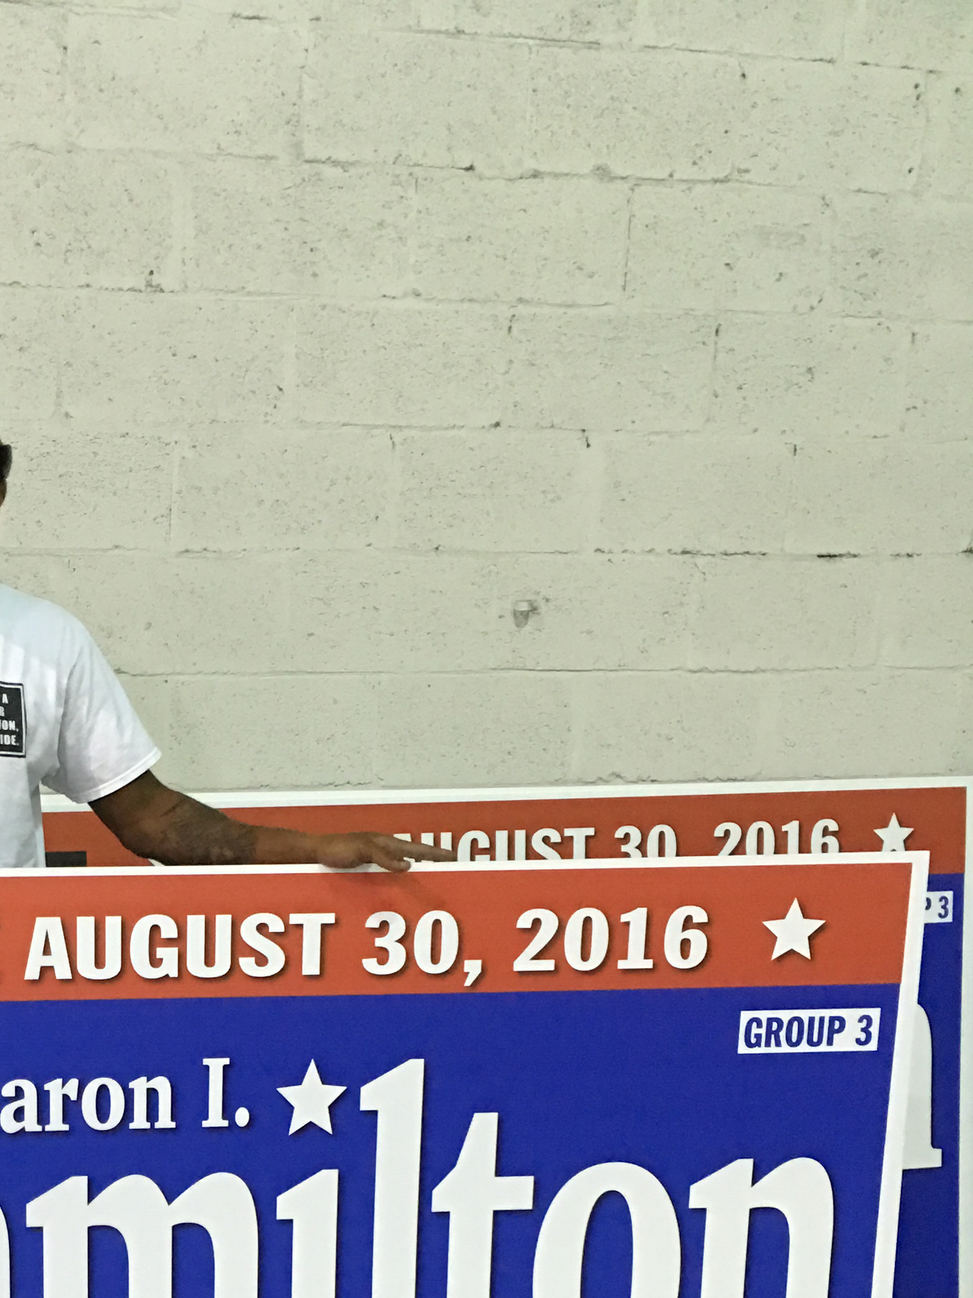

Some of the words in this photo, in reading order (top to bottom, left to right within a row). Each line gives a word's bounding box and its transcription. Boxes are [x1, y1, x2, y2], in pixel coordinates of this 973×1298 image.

[2, 693, 9, 704] A
[24, 912, 336, 981] AUGUST
[362, 911, 482, 987] 30,
[513, 906, 709, 972] 2016
[743, 1014, 846, 1049] GROUP
[854, 1013, 874, 1047] 3
[202, 1058, 250, 1128] I.
